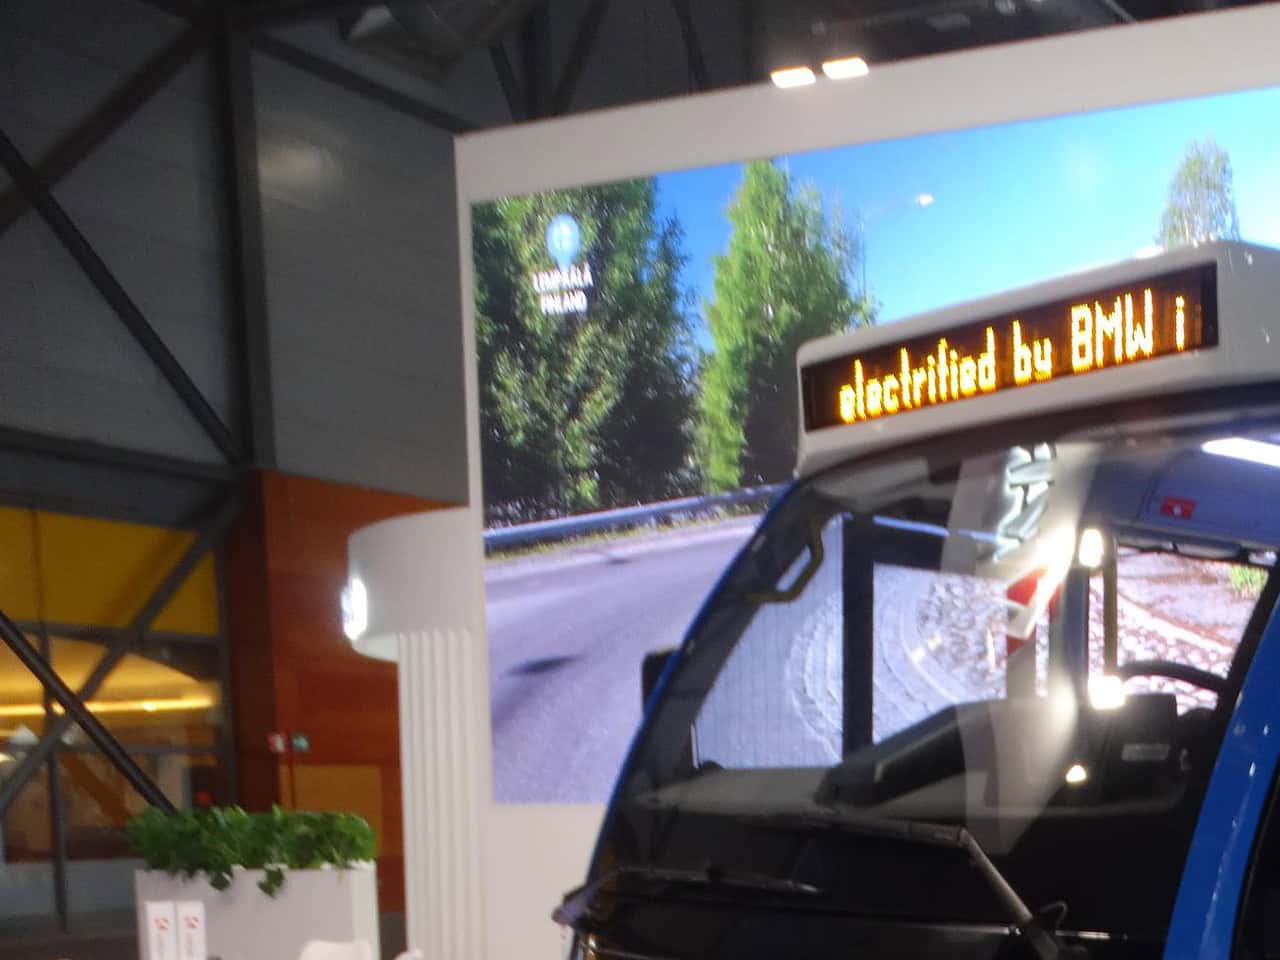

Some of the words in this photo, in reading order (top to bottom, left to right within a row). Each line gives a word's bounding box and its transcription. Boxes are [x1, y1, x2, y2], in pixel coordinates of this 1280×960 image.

[839, 325, 998, 424] electrified
[1013, 319, 1052, 384] by
[1070, 288, 1154, 374] BMW
[1175, 296, 1186, 351] i
